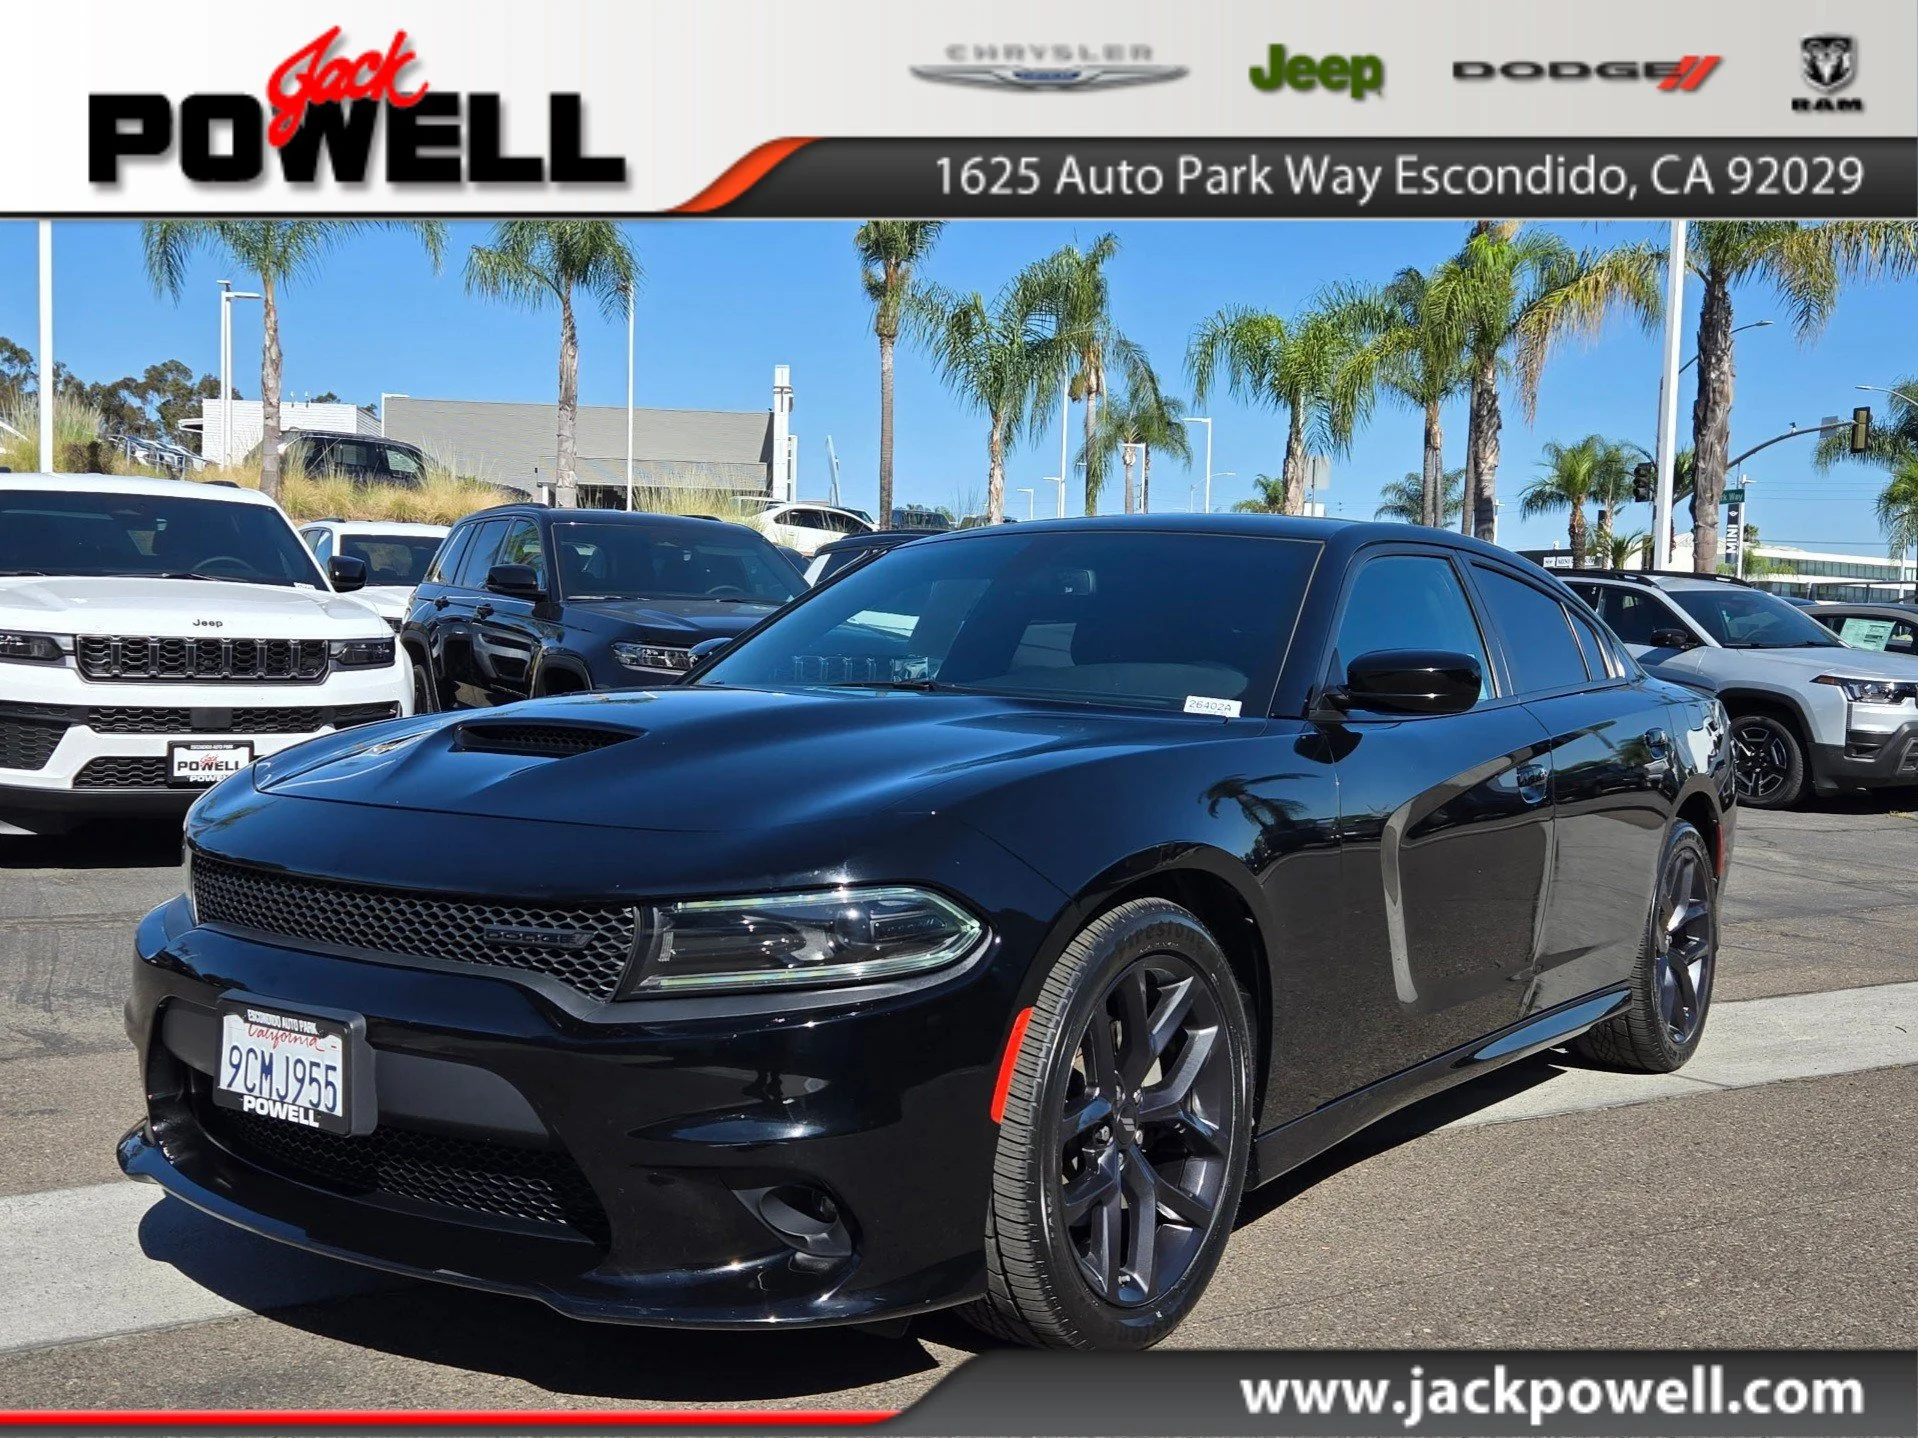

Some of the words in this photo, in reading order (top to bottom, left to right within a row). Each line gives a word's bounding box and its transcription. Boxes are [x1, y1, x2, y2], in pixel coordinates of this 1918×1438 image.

[1725, 524, 1739, 553] MINI
[192, 619, 223, 628] Jeep
[1189, 700, 1232, 711] 26402A
[227, 1044, 337, 1113] 9CMJ955
[242, 1094, 320, 1128] POWELL
